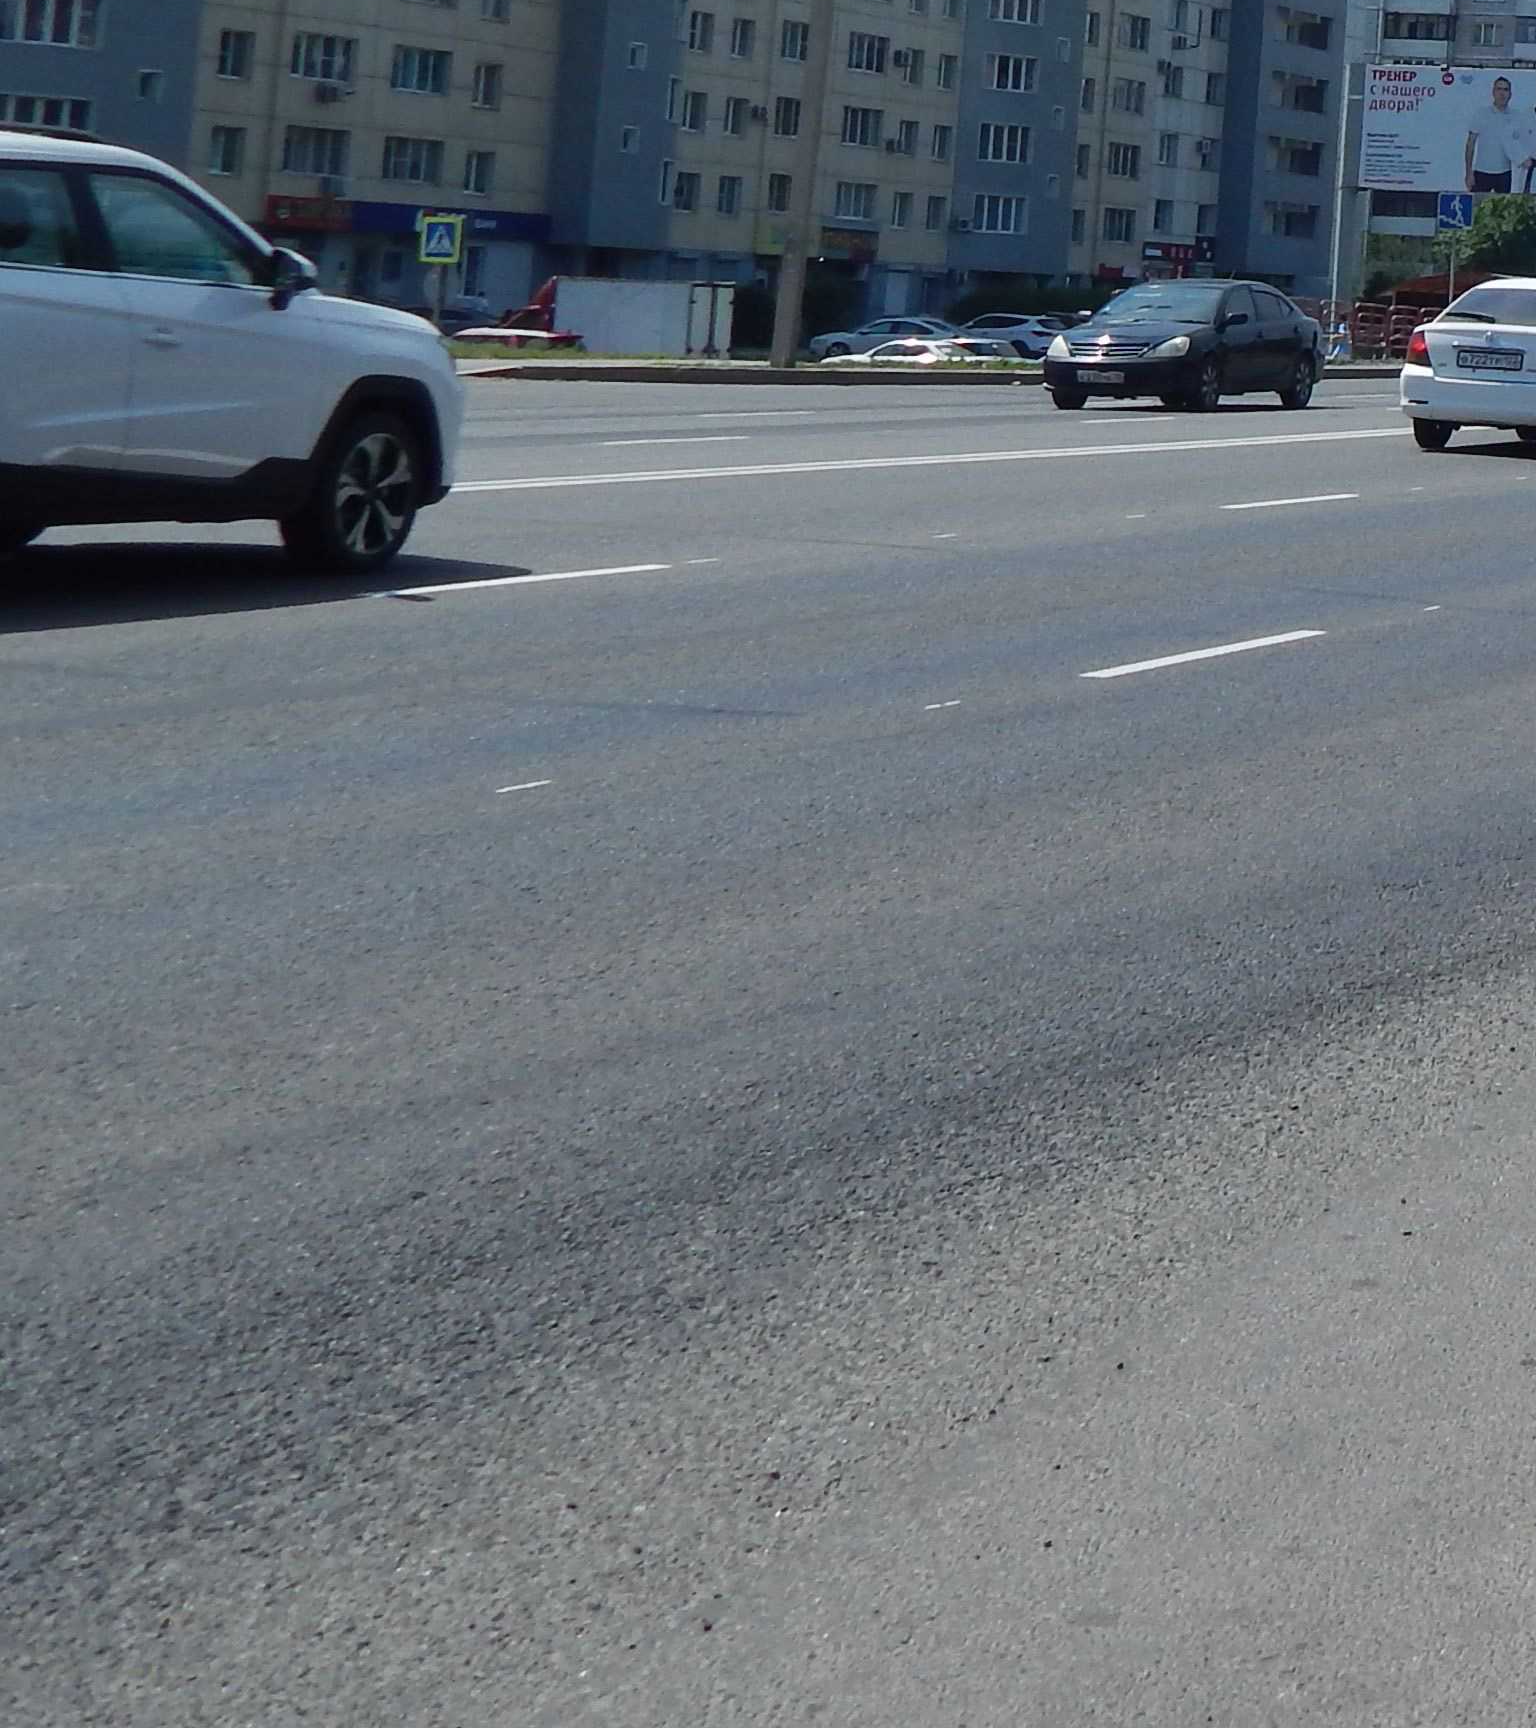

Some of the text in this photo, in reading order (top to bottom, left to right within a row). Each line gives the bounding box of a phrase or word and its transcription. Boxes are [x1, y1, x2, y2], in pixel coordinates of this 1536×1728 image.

[1371, 69, 1417, 83] ТРЕНЕР
[1370, 84, 1437, 98] с нашего
